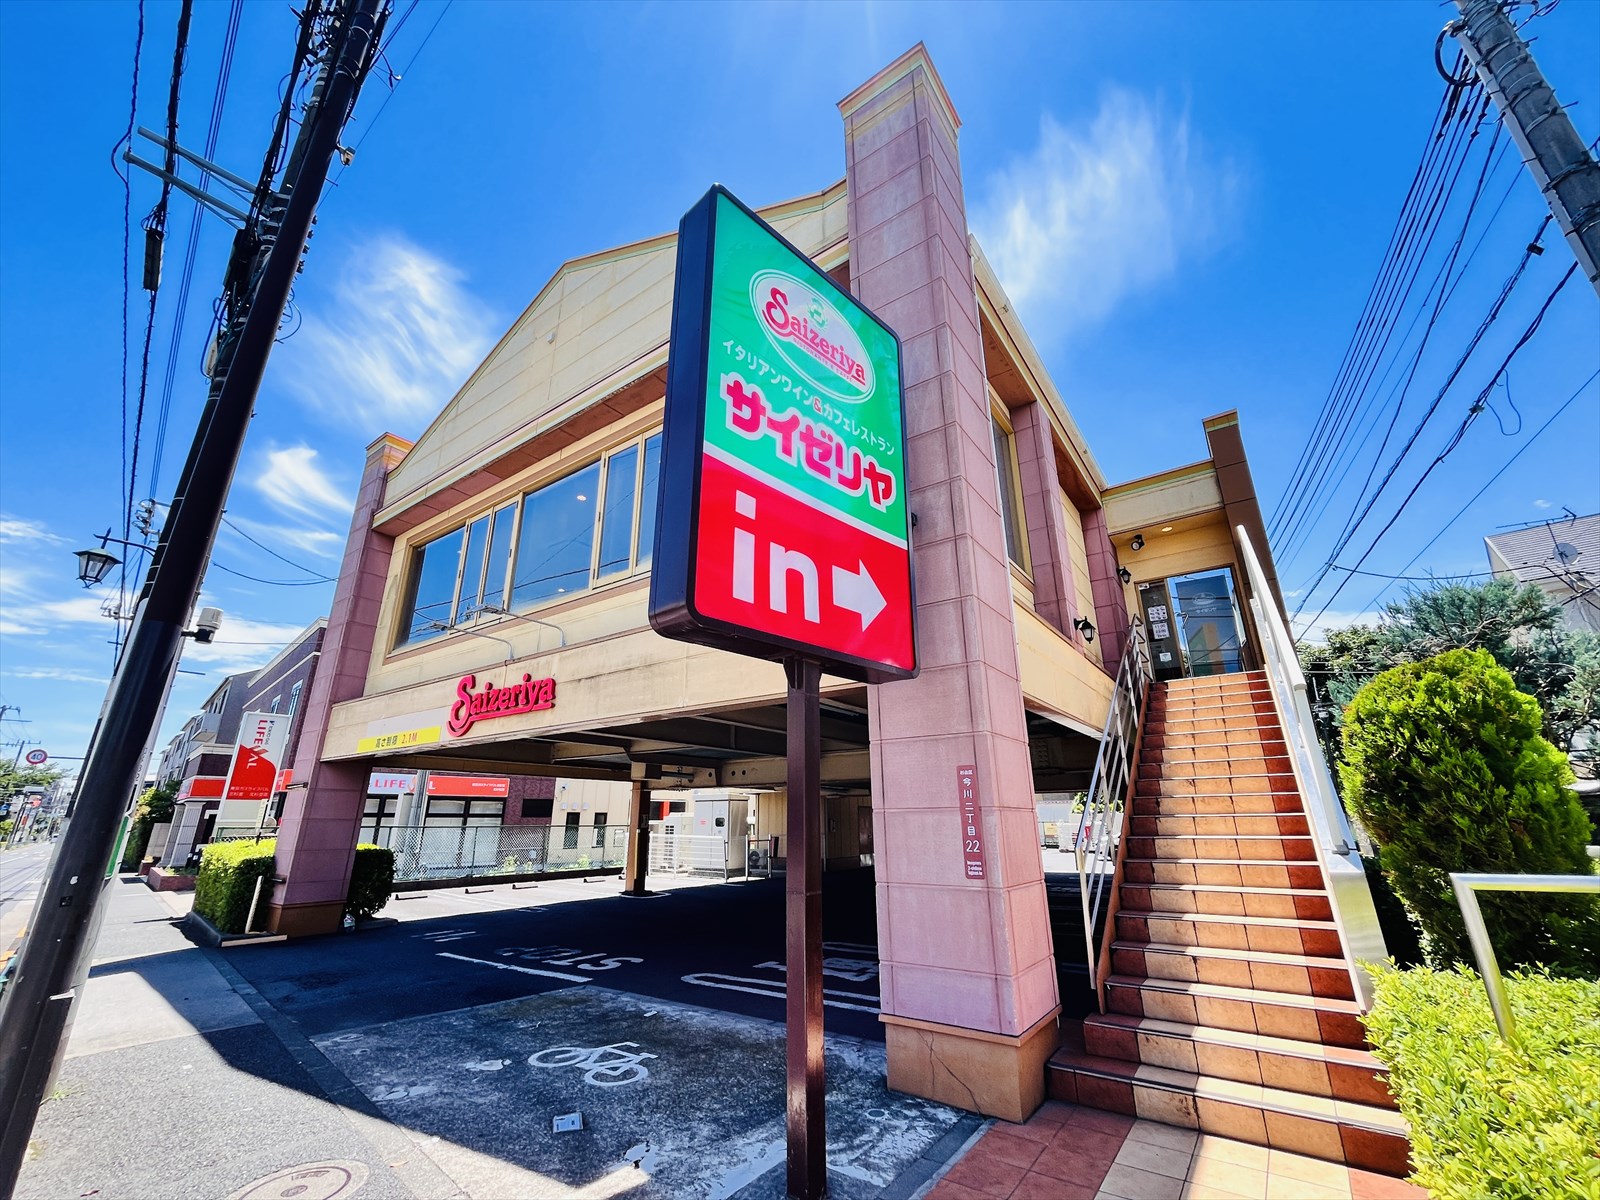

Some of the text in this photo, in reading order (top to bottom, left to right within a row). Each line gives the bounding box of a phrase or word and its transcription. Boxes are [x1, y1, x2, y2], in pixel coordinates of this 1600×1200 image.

[762, 287, 866, 386] Saizeriya
[723, 376, 894, 508] サイゼリヤ
[732, 489, 820, 624] in
[446, 673, 557, 737] Saizeriya
[30, 753, 43, 761] 40
[962, 777, 976, 836] 今川二丁目
[966, 839, 980, 853] 22
